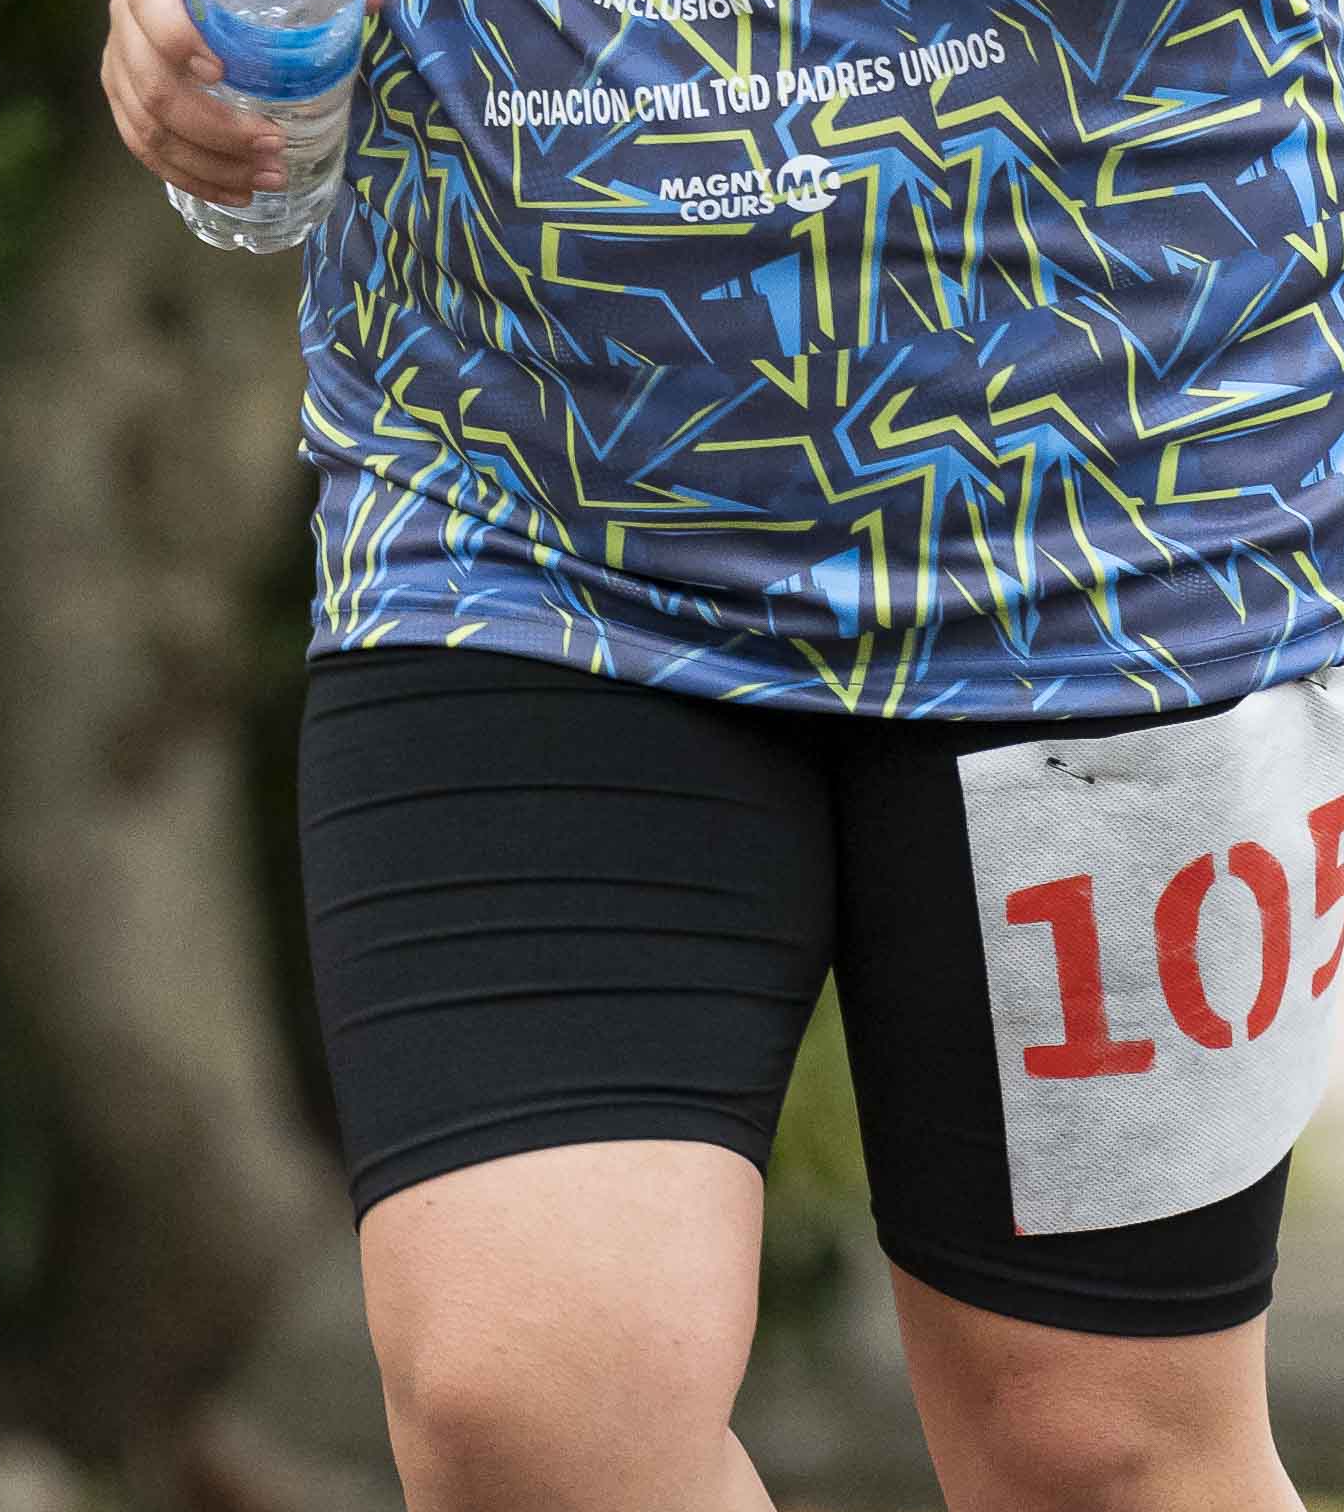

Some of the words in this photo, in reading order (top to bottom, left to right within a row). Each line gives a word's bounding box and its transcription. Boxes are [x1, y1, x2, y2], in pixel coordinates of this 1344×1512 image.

[484, 78, 632, 127] ASOCIACIÓN
[634, 81, 710, 122] CIVIL
[710, 74, 770, 114] TGD
[776, 56, 897, 108] PADRES
[898, 28, 1006, 87] UNIDOS
[659, 168, 771, 201] MAGNY
[679, 193, 776, 222] COURS
